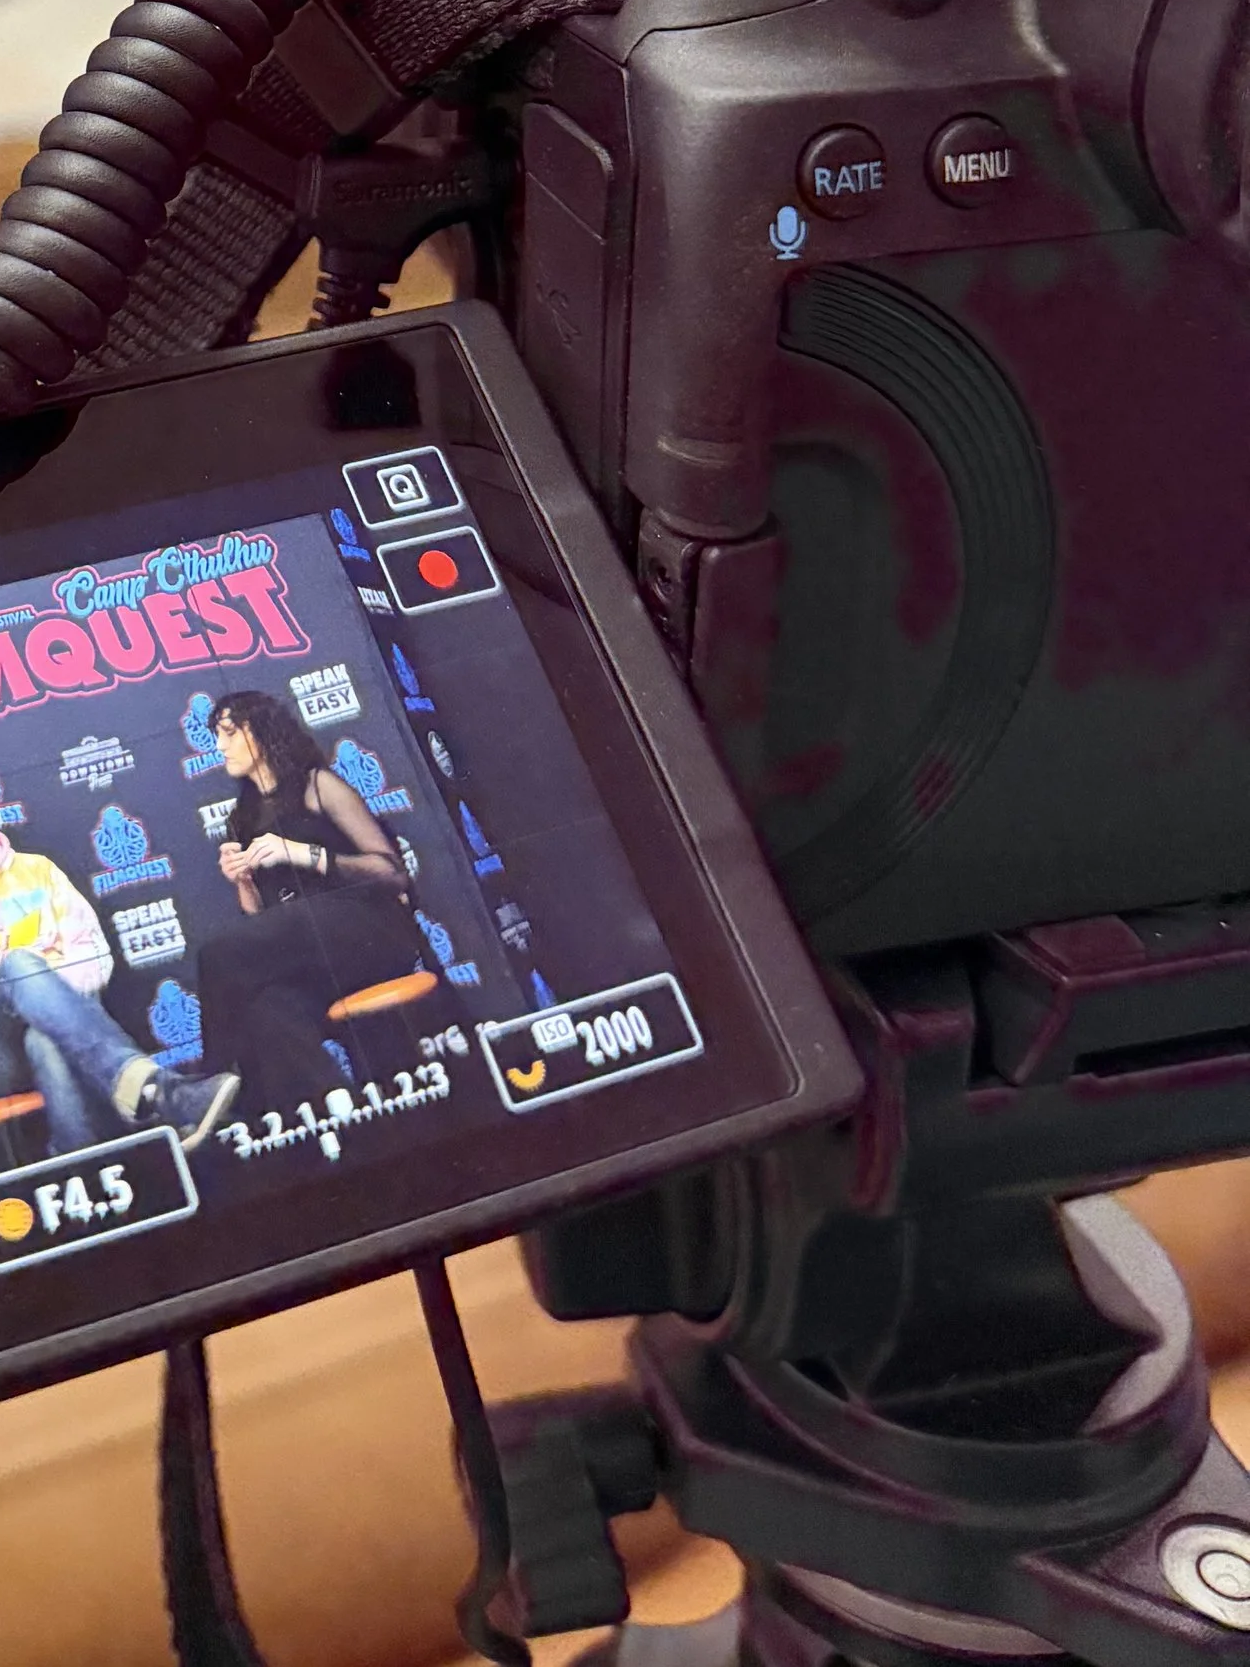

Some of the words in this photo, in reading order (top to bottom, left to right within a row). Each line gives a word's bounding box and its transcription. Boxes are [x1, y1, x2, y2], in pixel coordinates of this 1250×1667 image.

[813, 160, 883, 196] RATE
[943, 148, 1011, 183] MENU
[389, 473, 418, 500] Q
[58, 570, 149, 619] Camp
[148, 536, 273, 593] Cthulhu
[290, 663, 351, 698] SPEAK
[304, 688, 351, 716] EASY
[112, 897, 178, 933] SPEAK
[128, 925, 177, 953] EASY
[537, 1017, 571, 1044] ISO
[576, 1005, 654, 1068] 2000
[34, 1164, 134, 1236] F4.5
